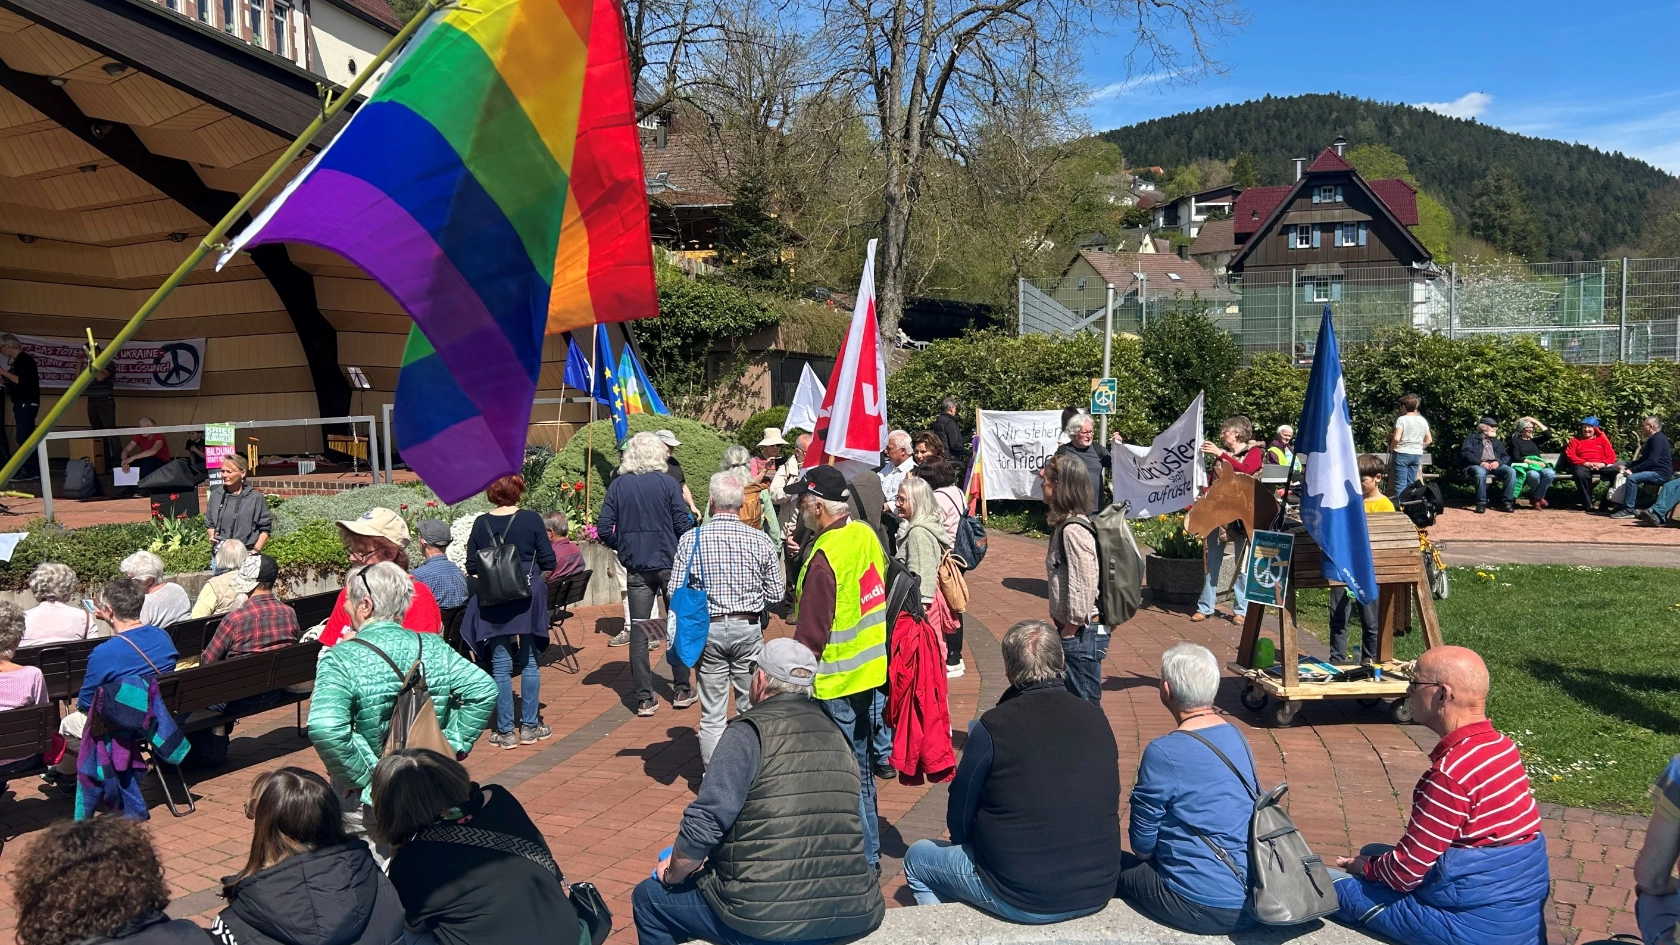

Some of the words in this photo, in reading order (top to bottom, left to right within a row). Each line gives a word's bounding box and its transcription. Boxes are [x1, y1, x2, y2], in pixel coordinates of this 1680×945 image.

[34, 345, 52, 355] DAS
[129, 361, 171, 373] LÖSUNG!
[206, 426, 235, 434] KRIEG
[991, 421, 1020, 440] Wir
[207, 447, 235, 456] BILDUNG
[997, 451, 1011, 470] für
[1011, 444, 1054, 470] Friede
[1168, 468, 1186, 483] statt
[1148, 480, 1192, 505] aufrüste
